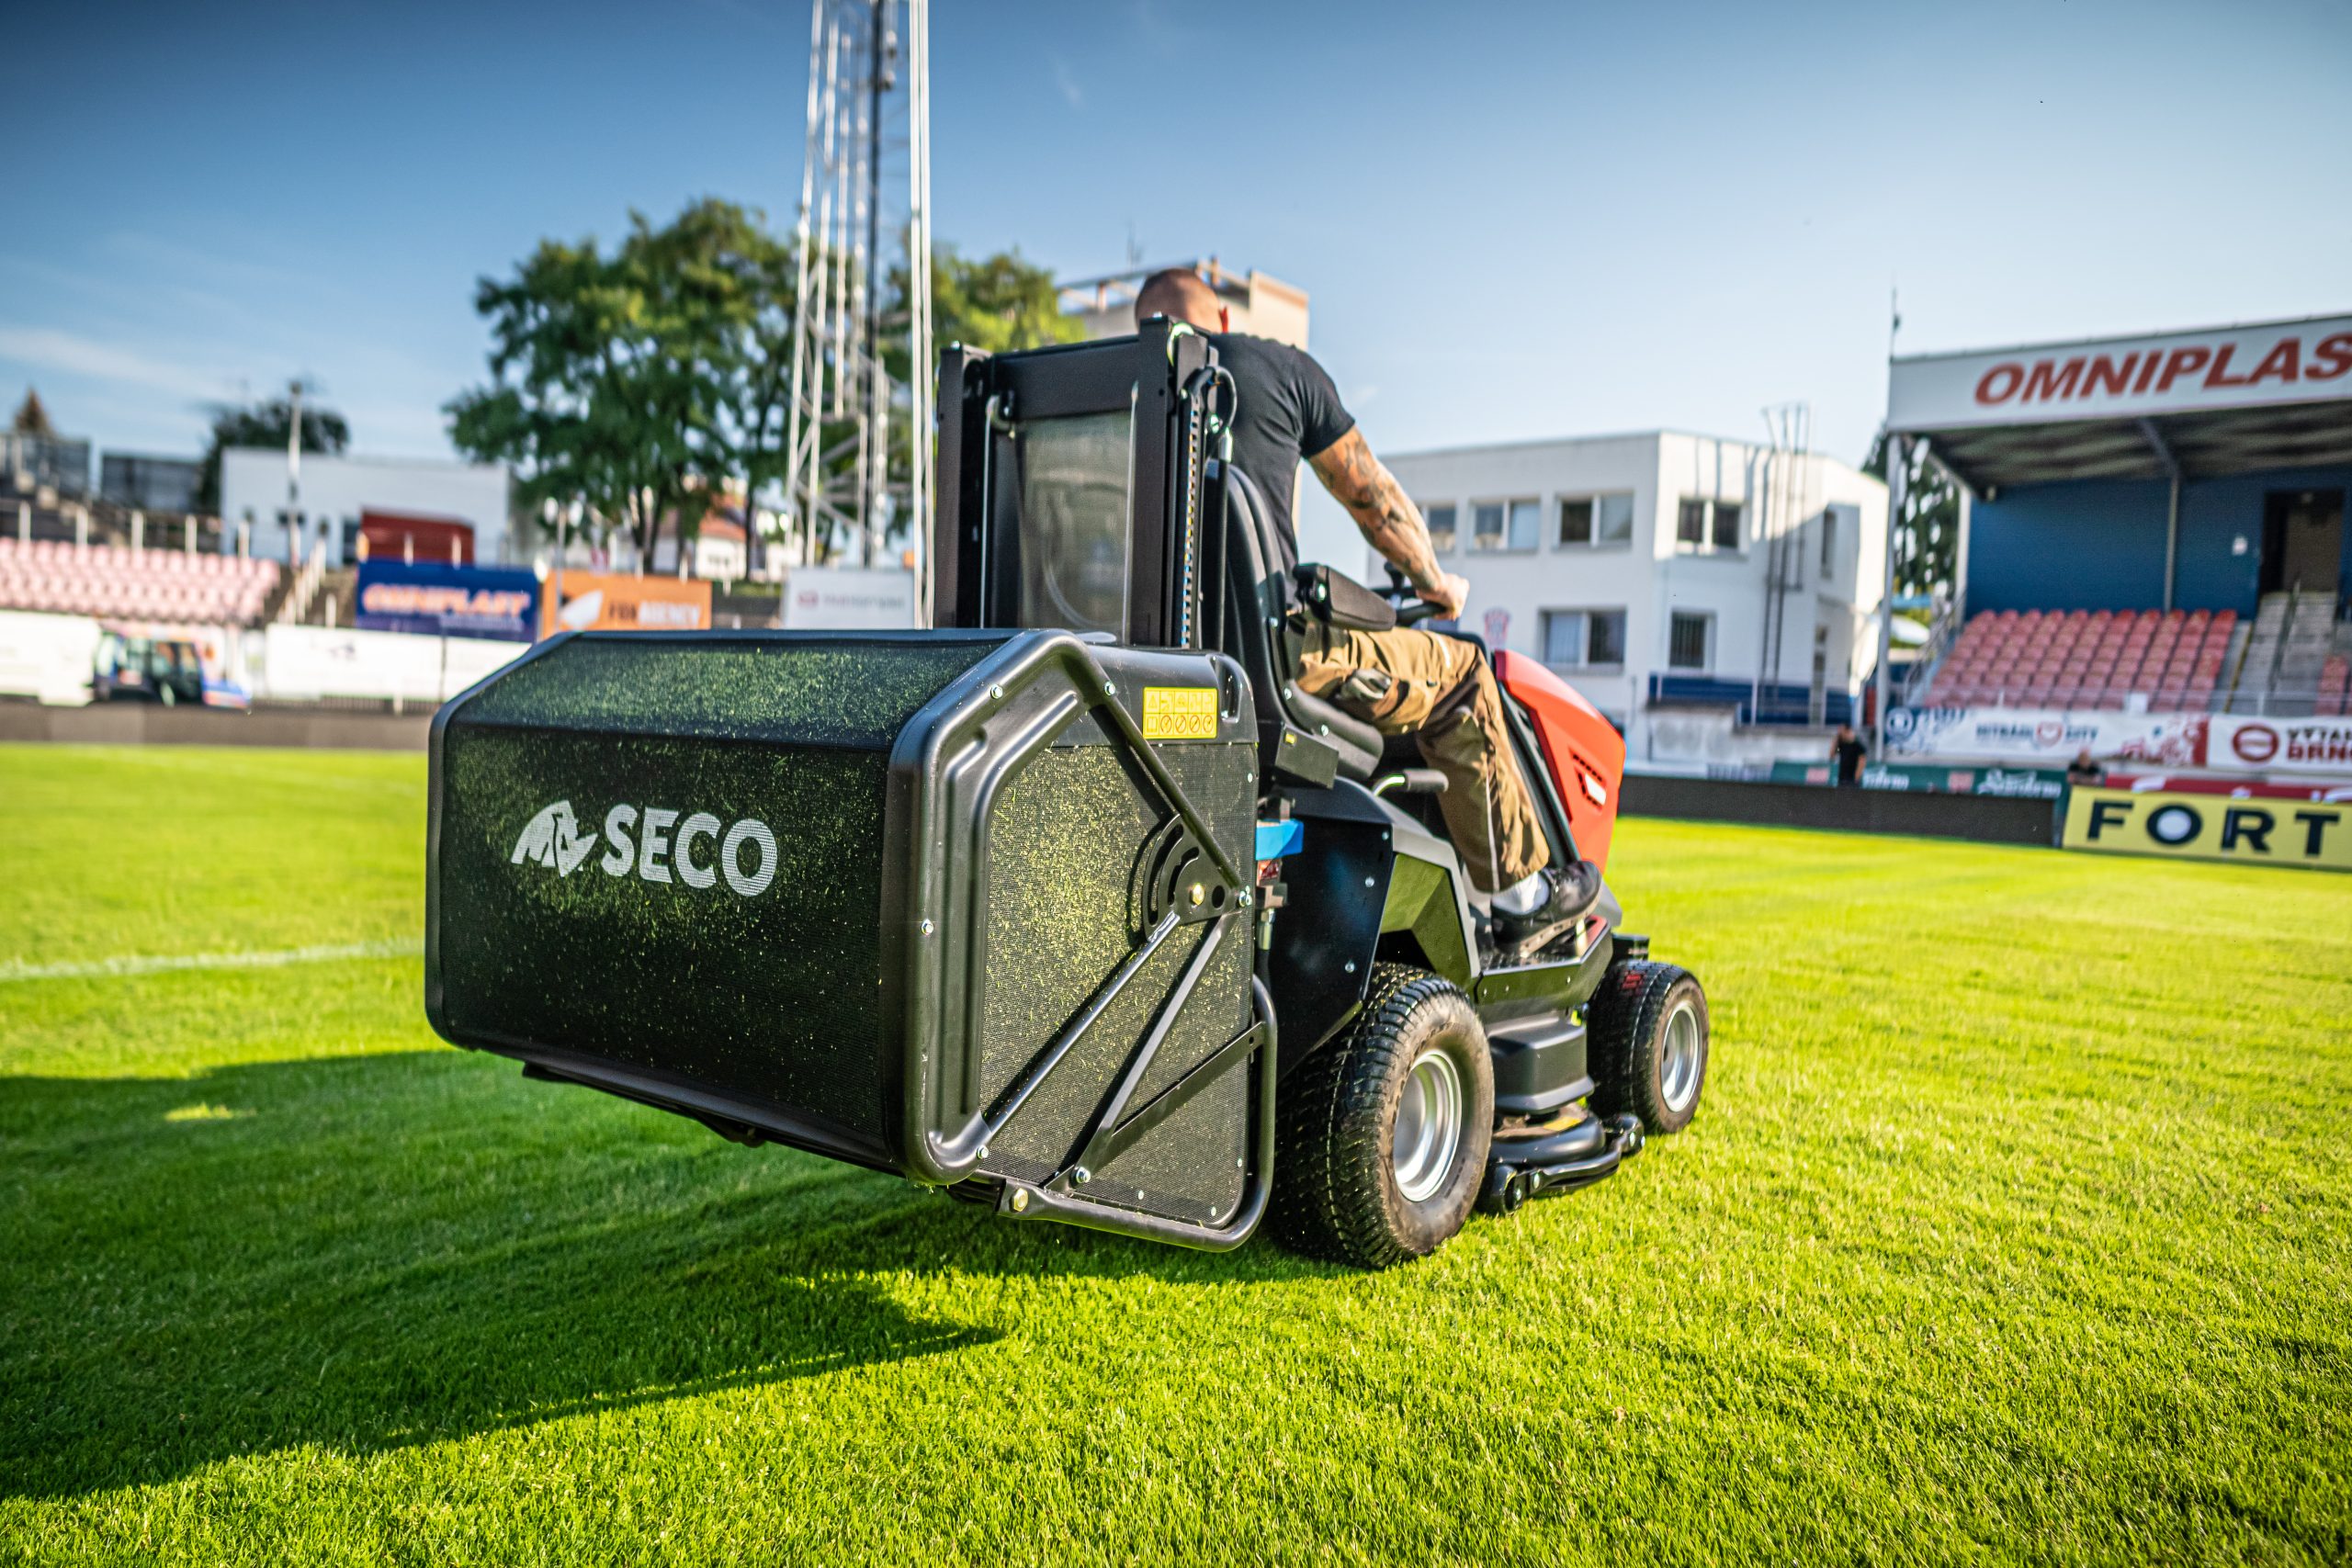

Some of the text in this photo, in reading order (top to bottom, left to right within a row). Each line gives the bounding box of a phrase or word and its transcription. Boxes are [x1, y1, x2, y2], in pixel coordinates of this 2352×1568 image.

[1974, 332, 2352, 406] OMNIPLAS
[600, 803, 778, 897] SECO
[2087, 799, 2341, 857] FORT
